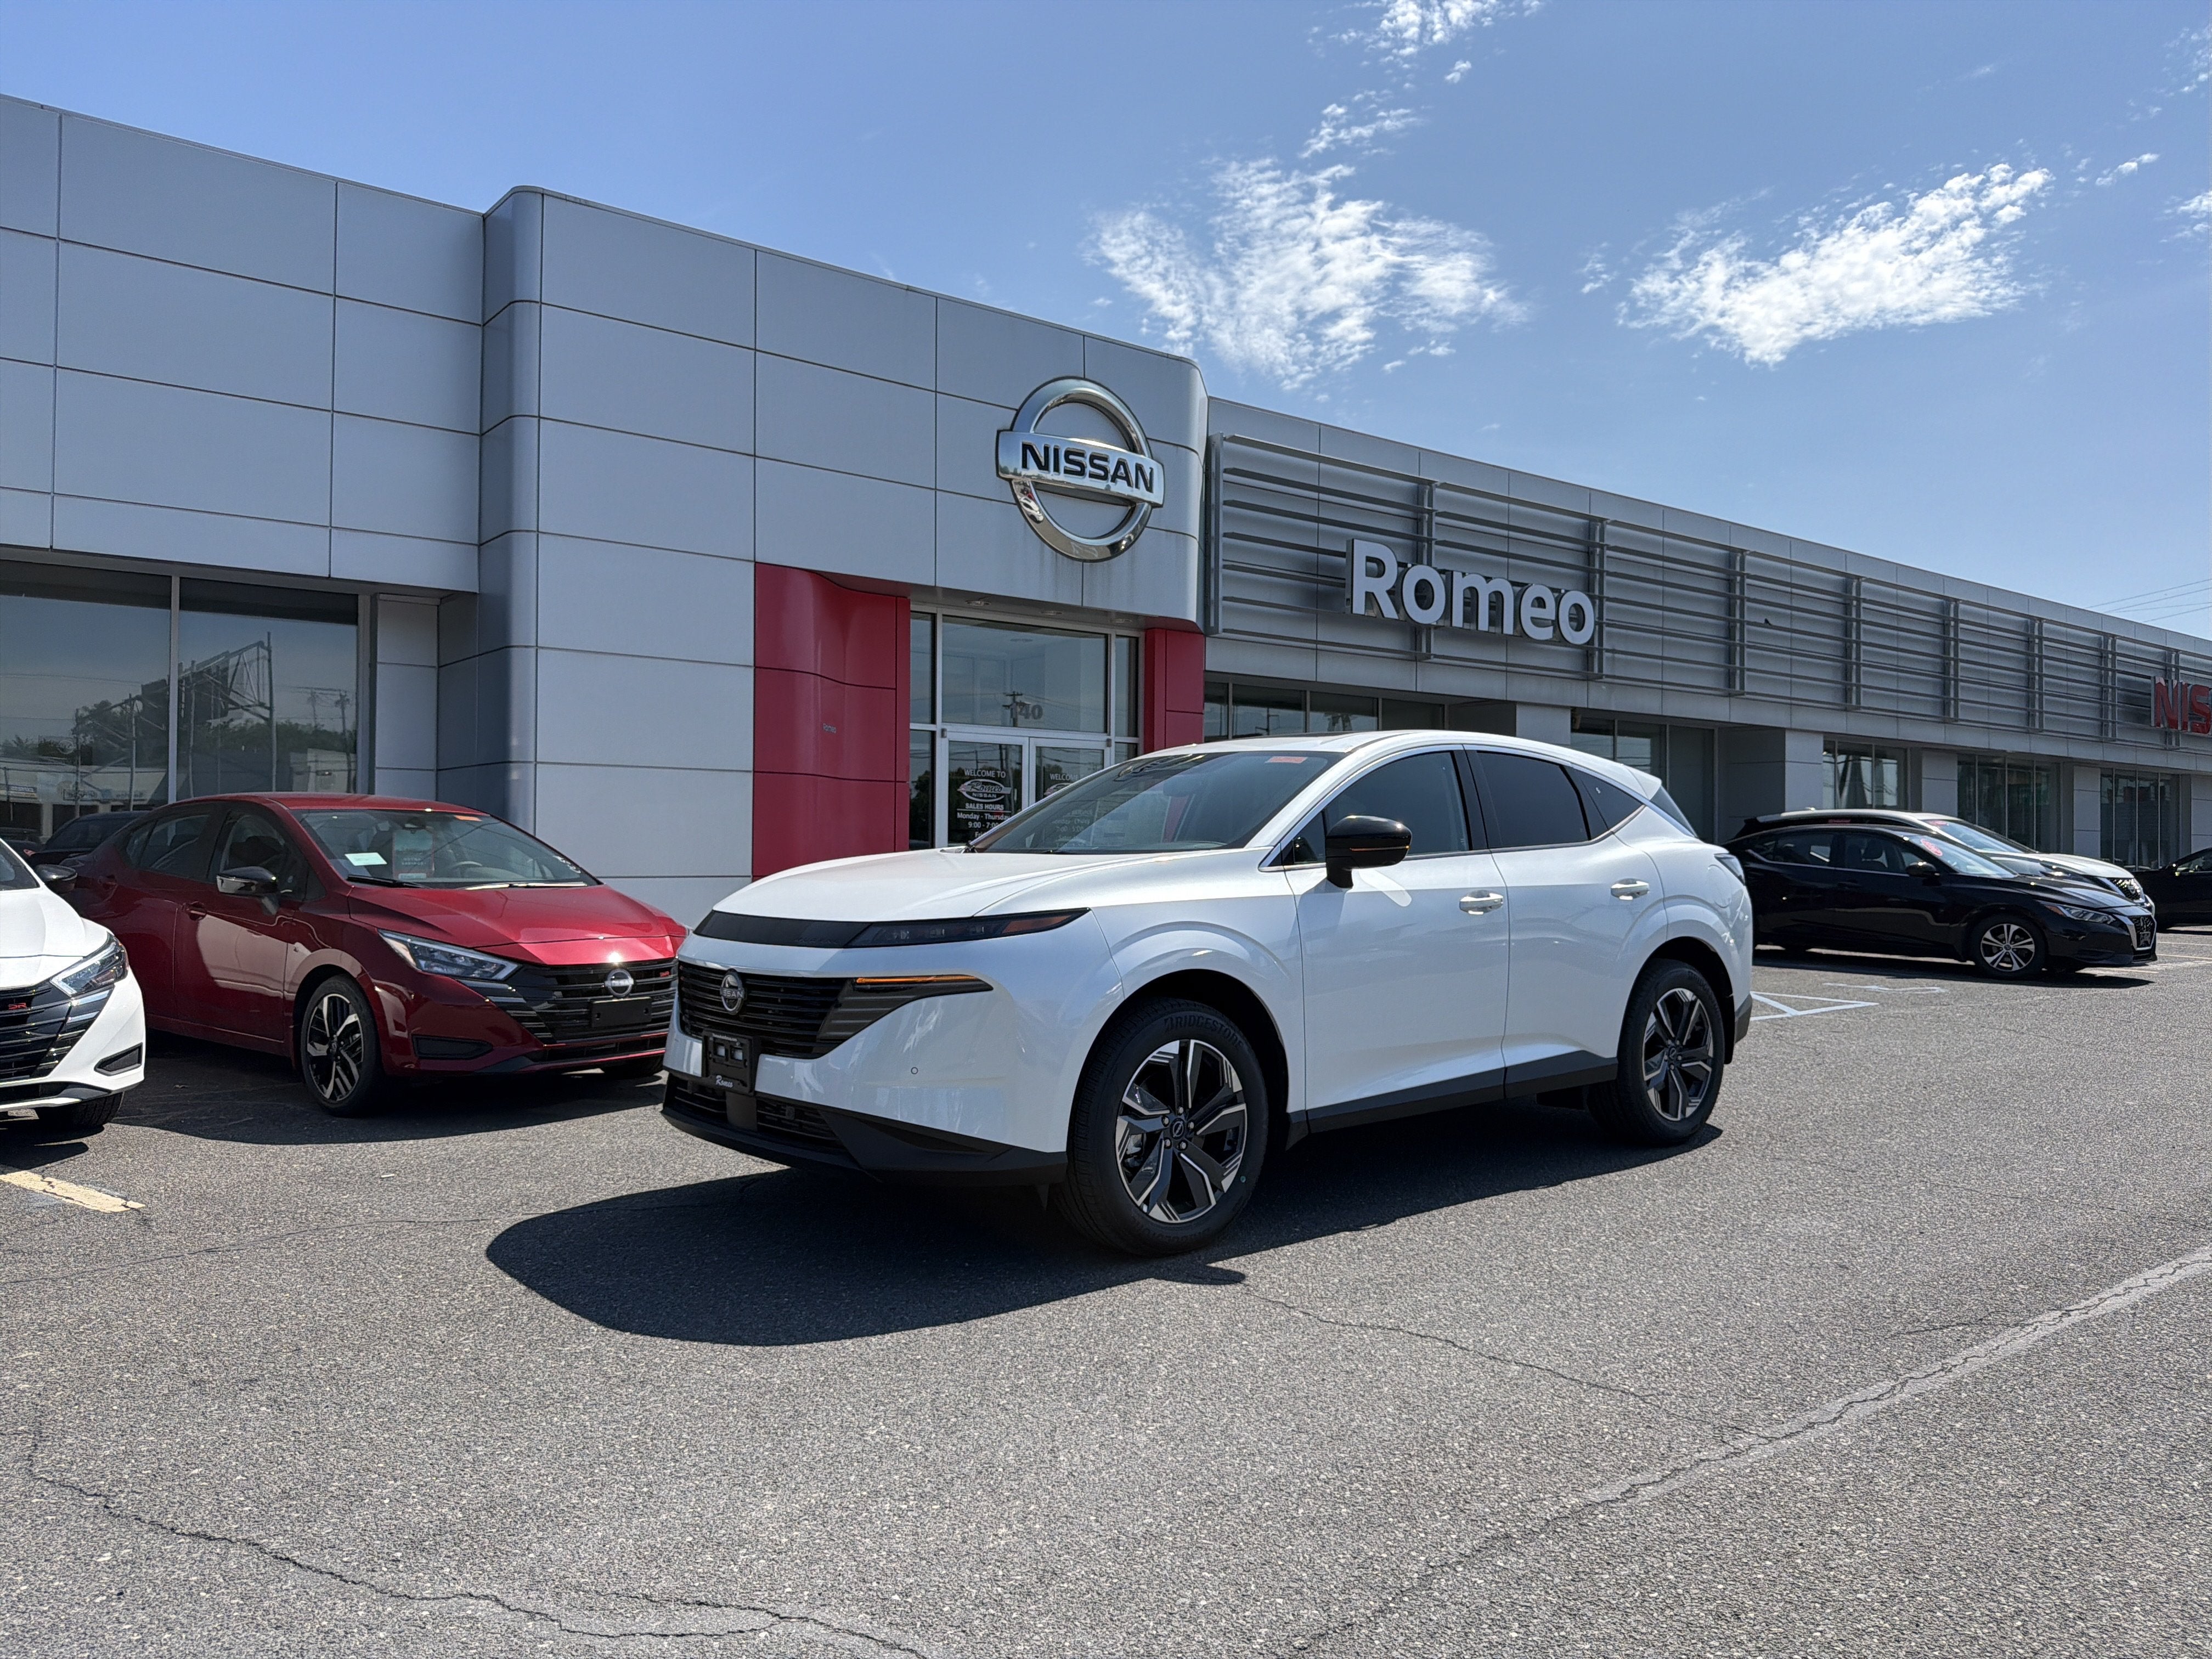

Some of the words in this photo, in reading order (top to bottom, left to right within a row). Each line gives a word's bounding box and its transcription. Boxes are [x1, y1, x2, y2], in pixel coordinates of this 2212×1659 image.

[1021, 441, 1154, 494] NISSAN
[1347, 538, 1595, 645] Romeo
[965, 769, 995, 777] WELCOME
[967, 781, 1002, 792] Romeo
